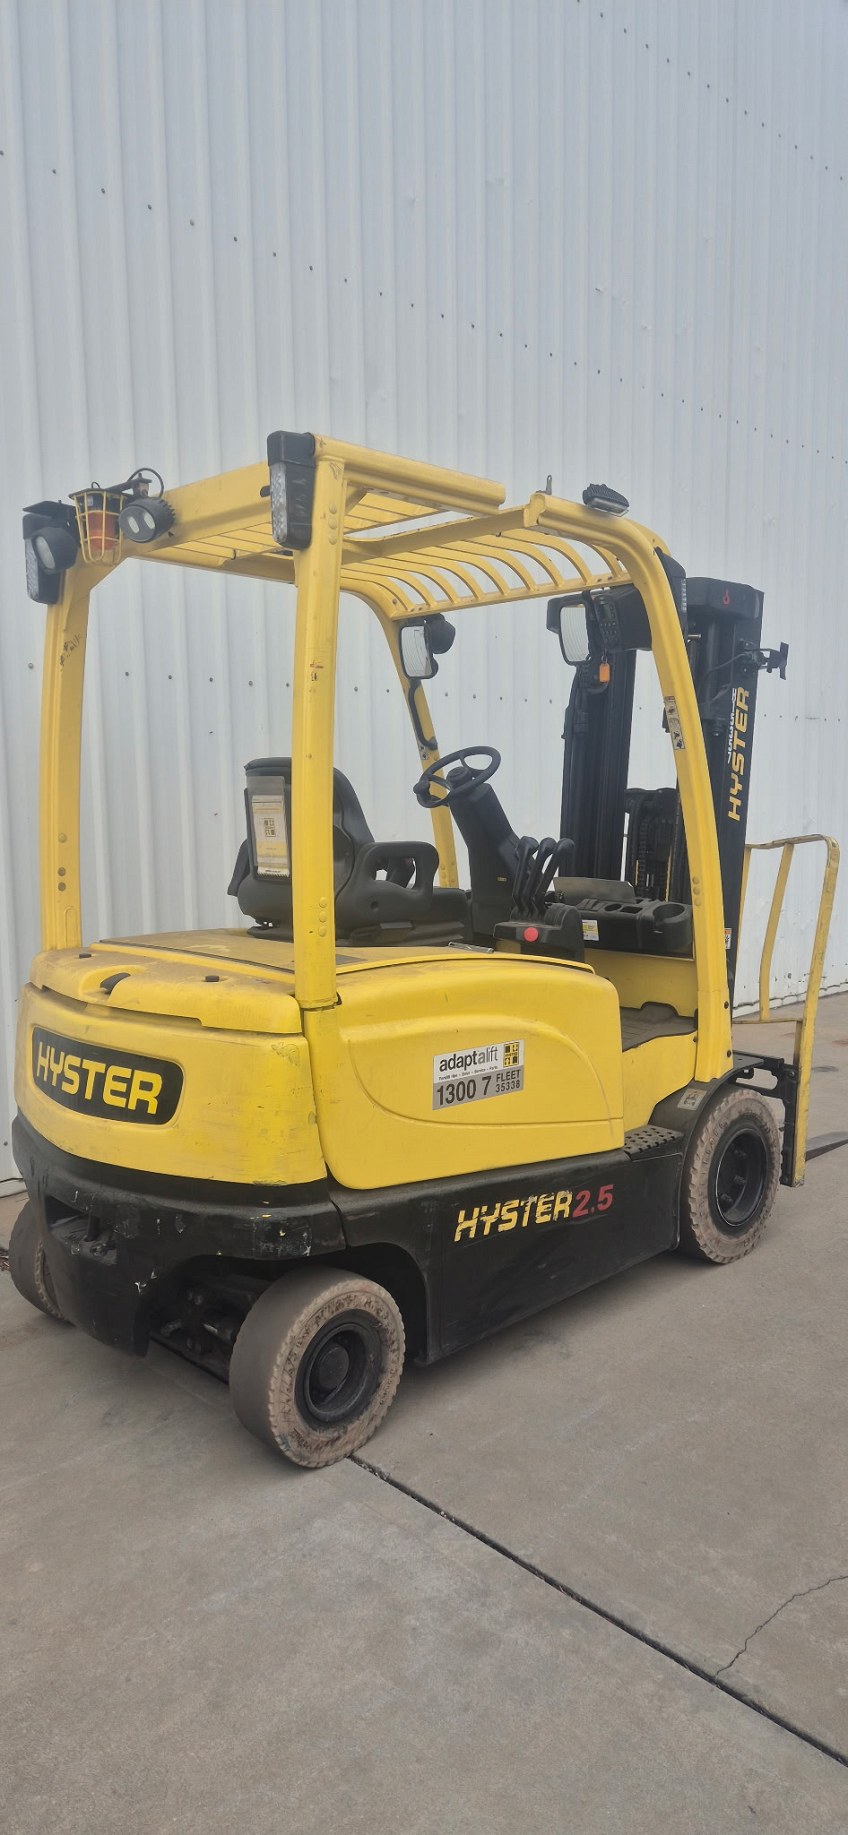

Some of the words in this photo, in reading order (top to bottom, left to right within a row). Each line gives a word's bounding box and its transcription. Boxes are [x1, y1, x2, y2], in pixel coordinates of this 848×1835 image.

[727, 687, 750, 821] HYSTER
[439, 1046, 498, 1072] adaptalift
[36, 1041, 162, 1115] HYSTER
[437, 1079, 477, 1106] 1300
[481, 1075, 492, 1096] 7
[495, 1079, 520, 1093] 35338
[496, 1069, 521, 1083] FLEET
[454, 1190, 573, 1242] HYSTER
[572, 1184, 614, 1218] 2.5
